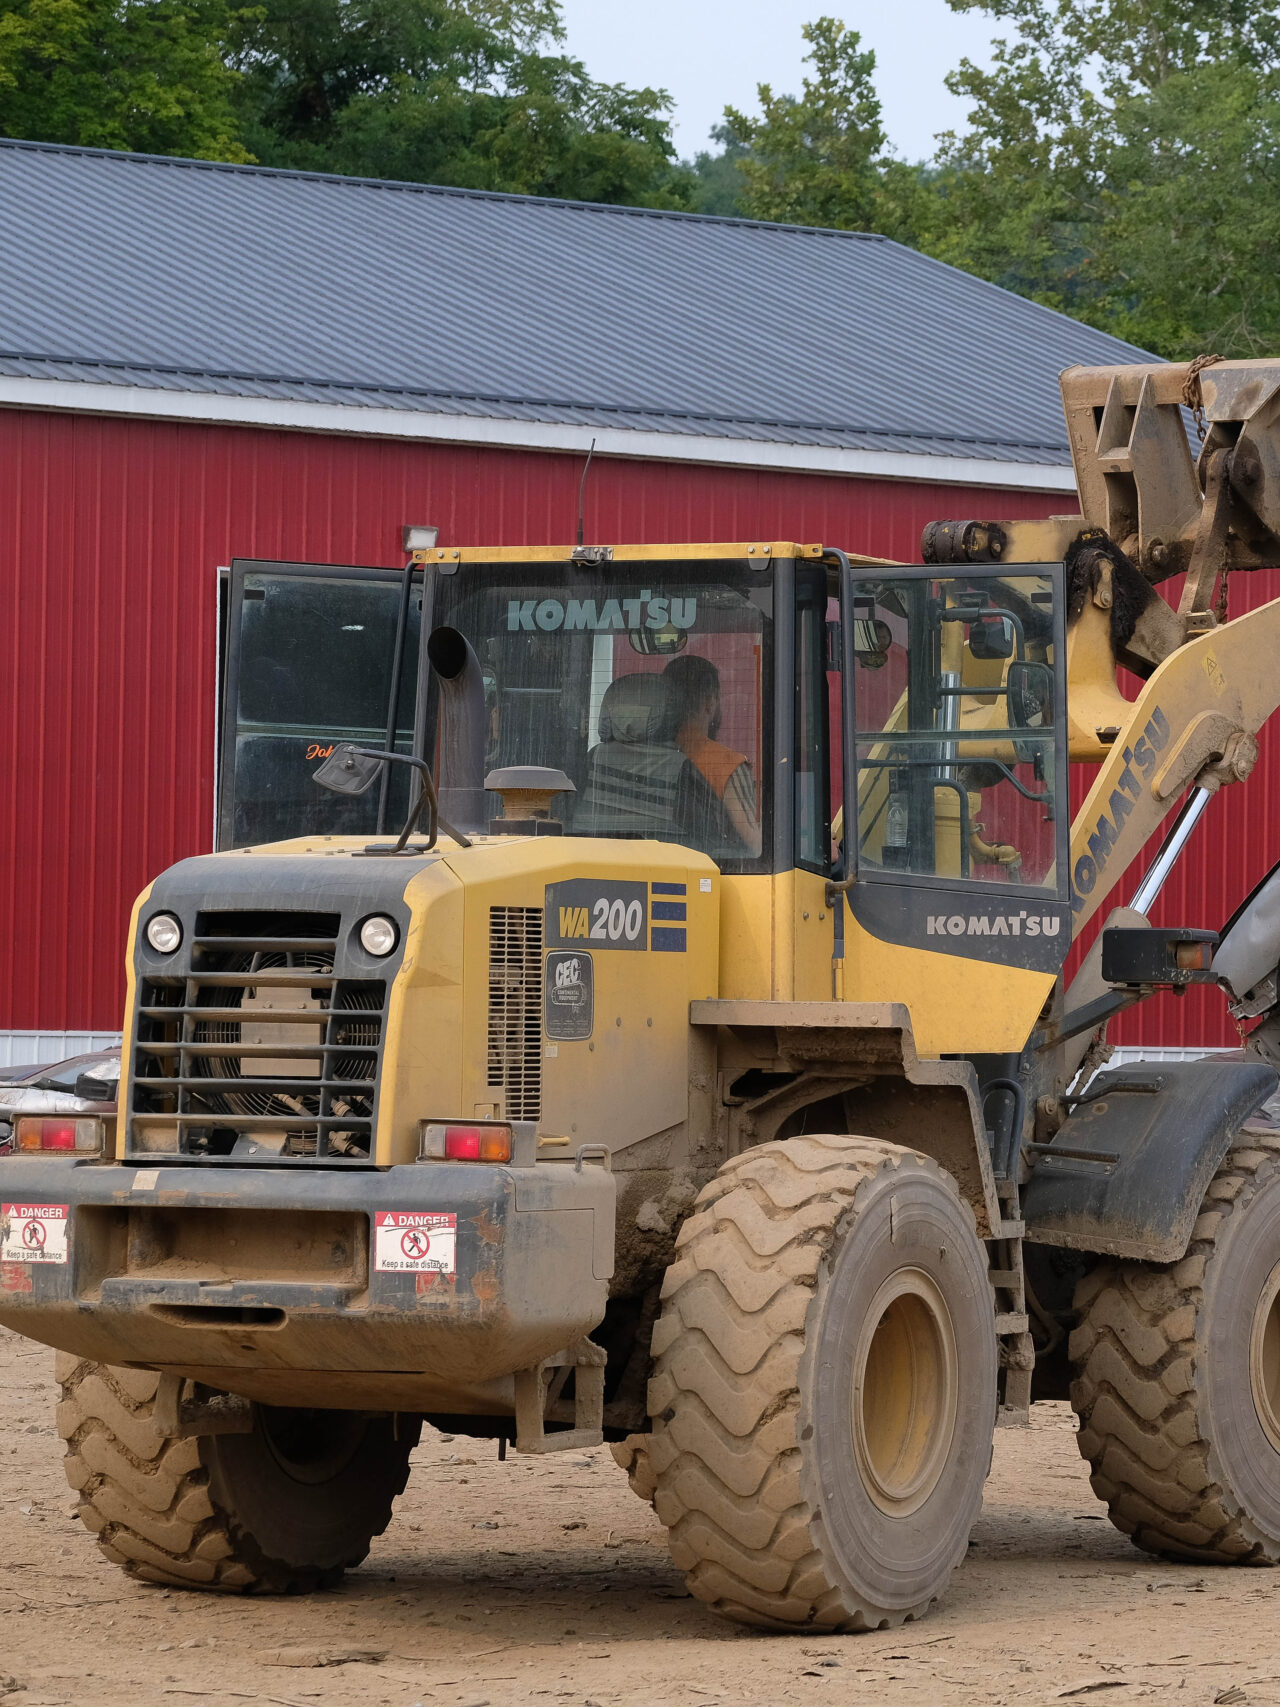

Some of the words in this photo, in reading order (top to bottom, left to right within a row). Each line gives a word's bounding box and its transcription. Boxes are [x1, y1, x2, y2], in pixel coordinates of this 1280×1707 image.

[507, 590, 697, 632] KOMATSU
[926, 910, 1060, 937] KOMATSU
[555, 958, 581, 987] CEC
[20, 1207, 63, 1218] DANGER
[398, 1215, 449, 1227] DANGER
[7, 1250, 20, 1260] Keep
[26, 1251, 38, 1259] safe
[382, 1260, 399, 1269] Keep
[405, 1260, 420, 1268] safe
[420, 1260, 449, 1269] distance
